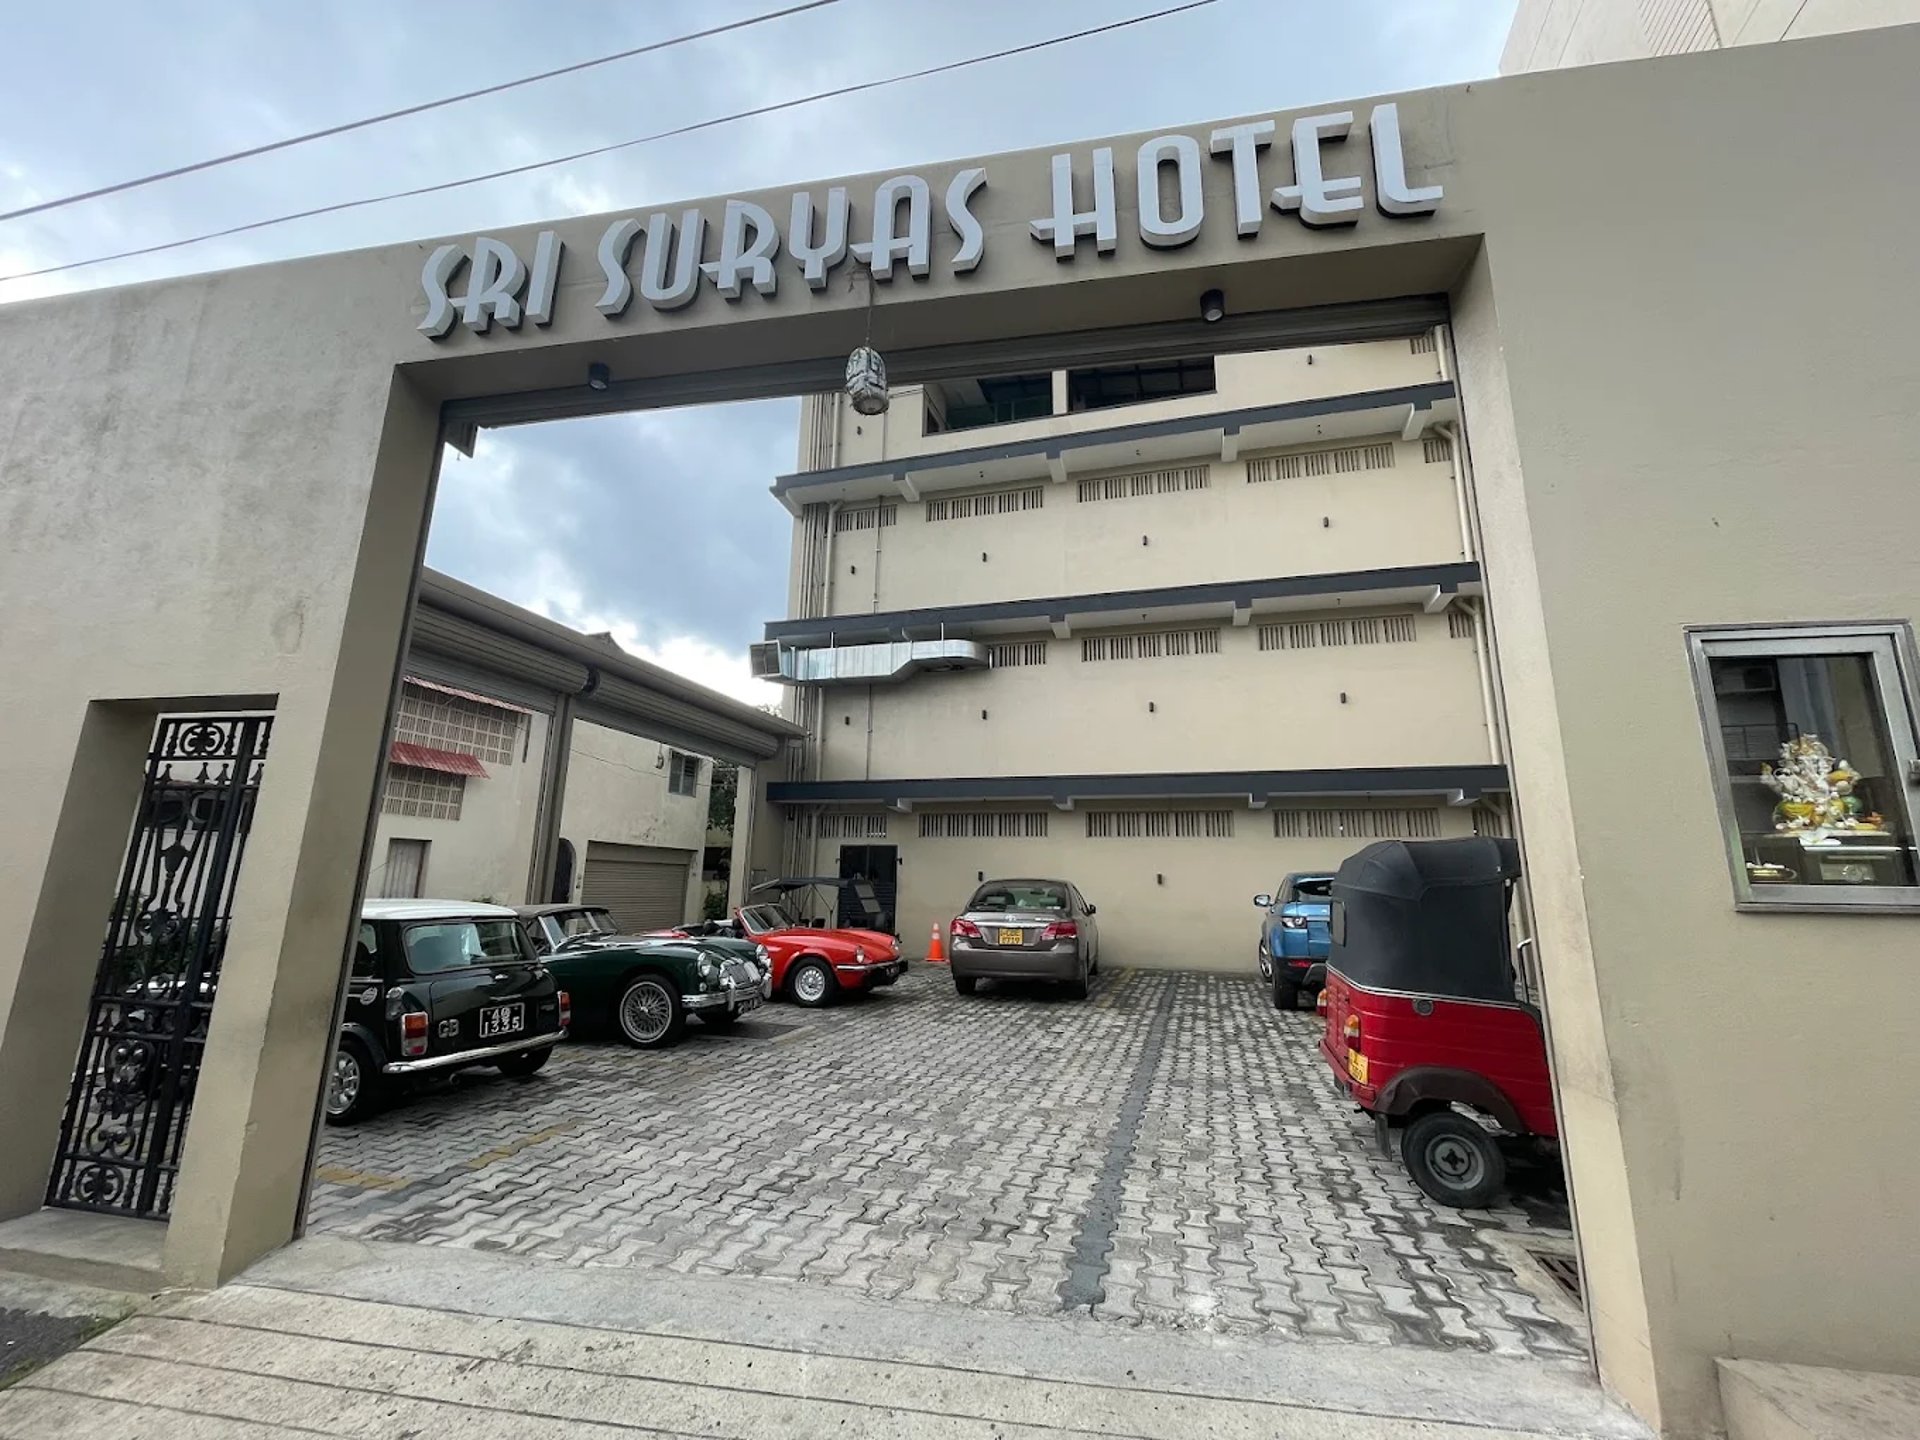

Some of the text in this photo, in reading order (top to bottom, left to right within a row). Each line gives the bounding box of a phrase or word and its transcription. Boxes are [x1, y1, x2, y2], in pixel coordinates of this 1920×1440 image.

[416, 102, 1444, 338] SRI SURYAS HOTEL
